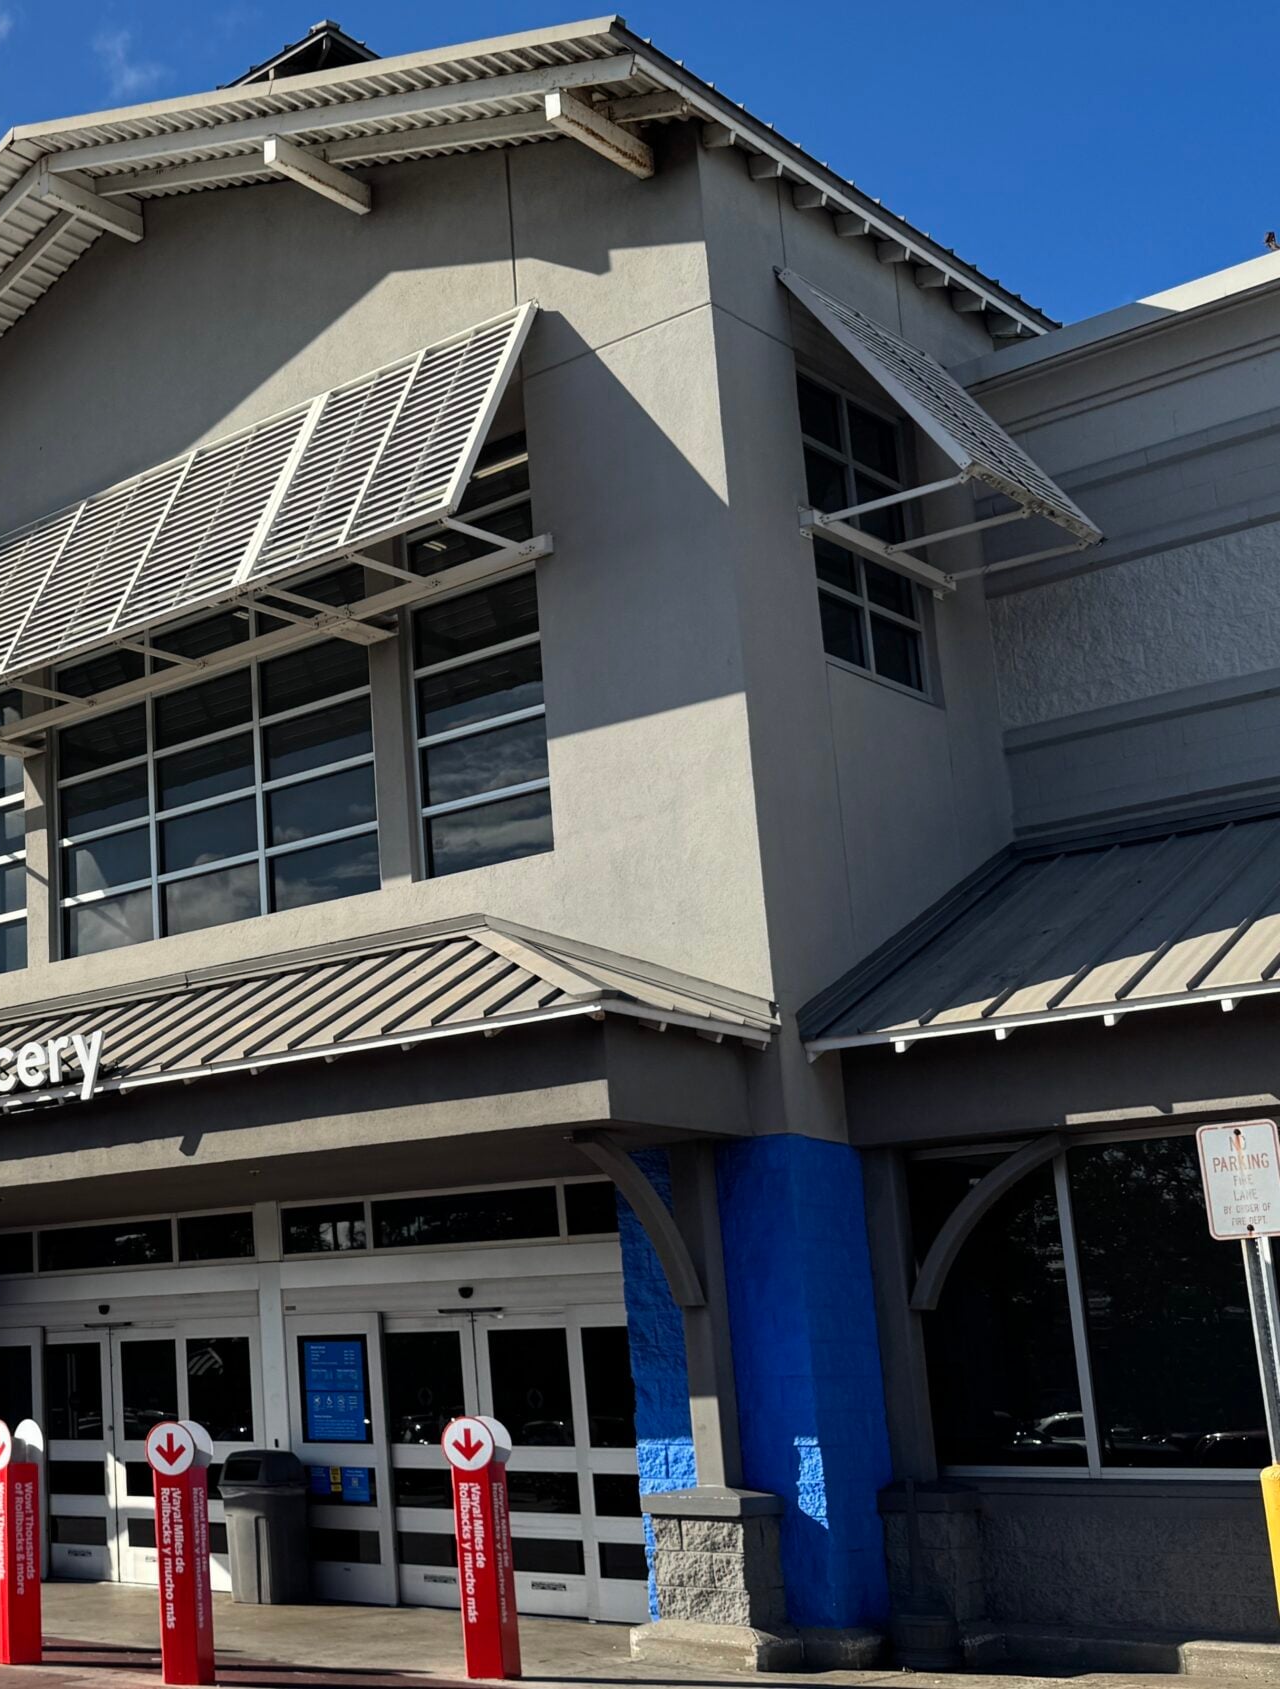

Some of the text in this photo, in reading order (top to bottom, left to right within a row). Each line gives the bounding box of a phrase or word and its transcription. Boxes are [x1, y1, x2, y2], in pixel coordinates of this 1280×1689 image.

[1229, 1135, 1247, 1152] NO
[1223, 1205, 1232, 1215] BY
[1263, 1202, 1271, 1212] OF
[15, 1482, 26, 1595] of Rollbacks & more
[24, 1482, 36, 1580] Wow! Thousands
[170, 1488, 186, 1574] ¡Vaya! Miles de
[458, 1482, 472, 1540] Rollbacks
[469, 1482, 486, 1568] ¡Vaya! Miles de
[161, 1488, 176, 1629] Rollbacks y mucho más
[464, 1552, 476, 1595] mucho
[467, 1597, 479, 1624] más
